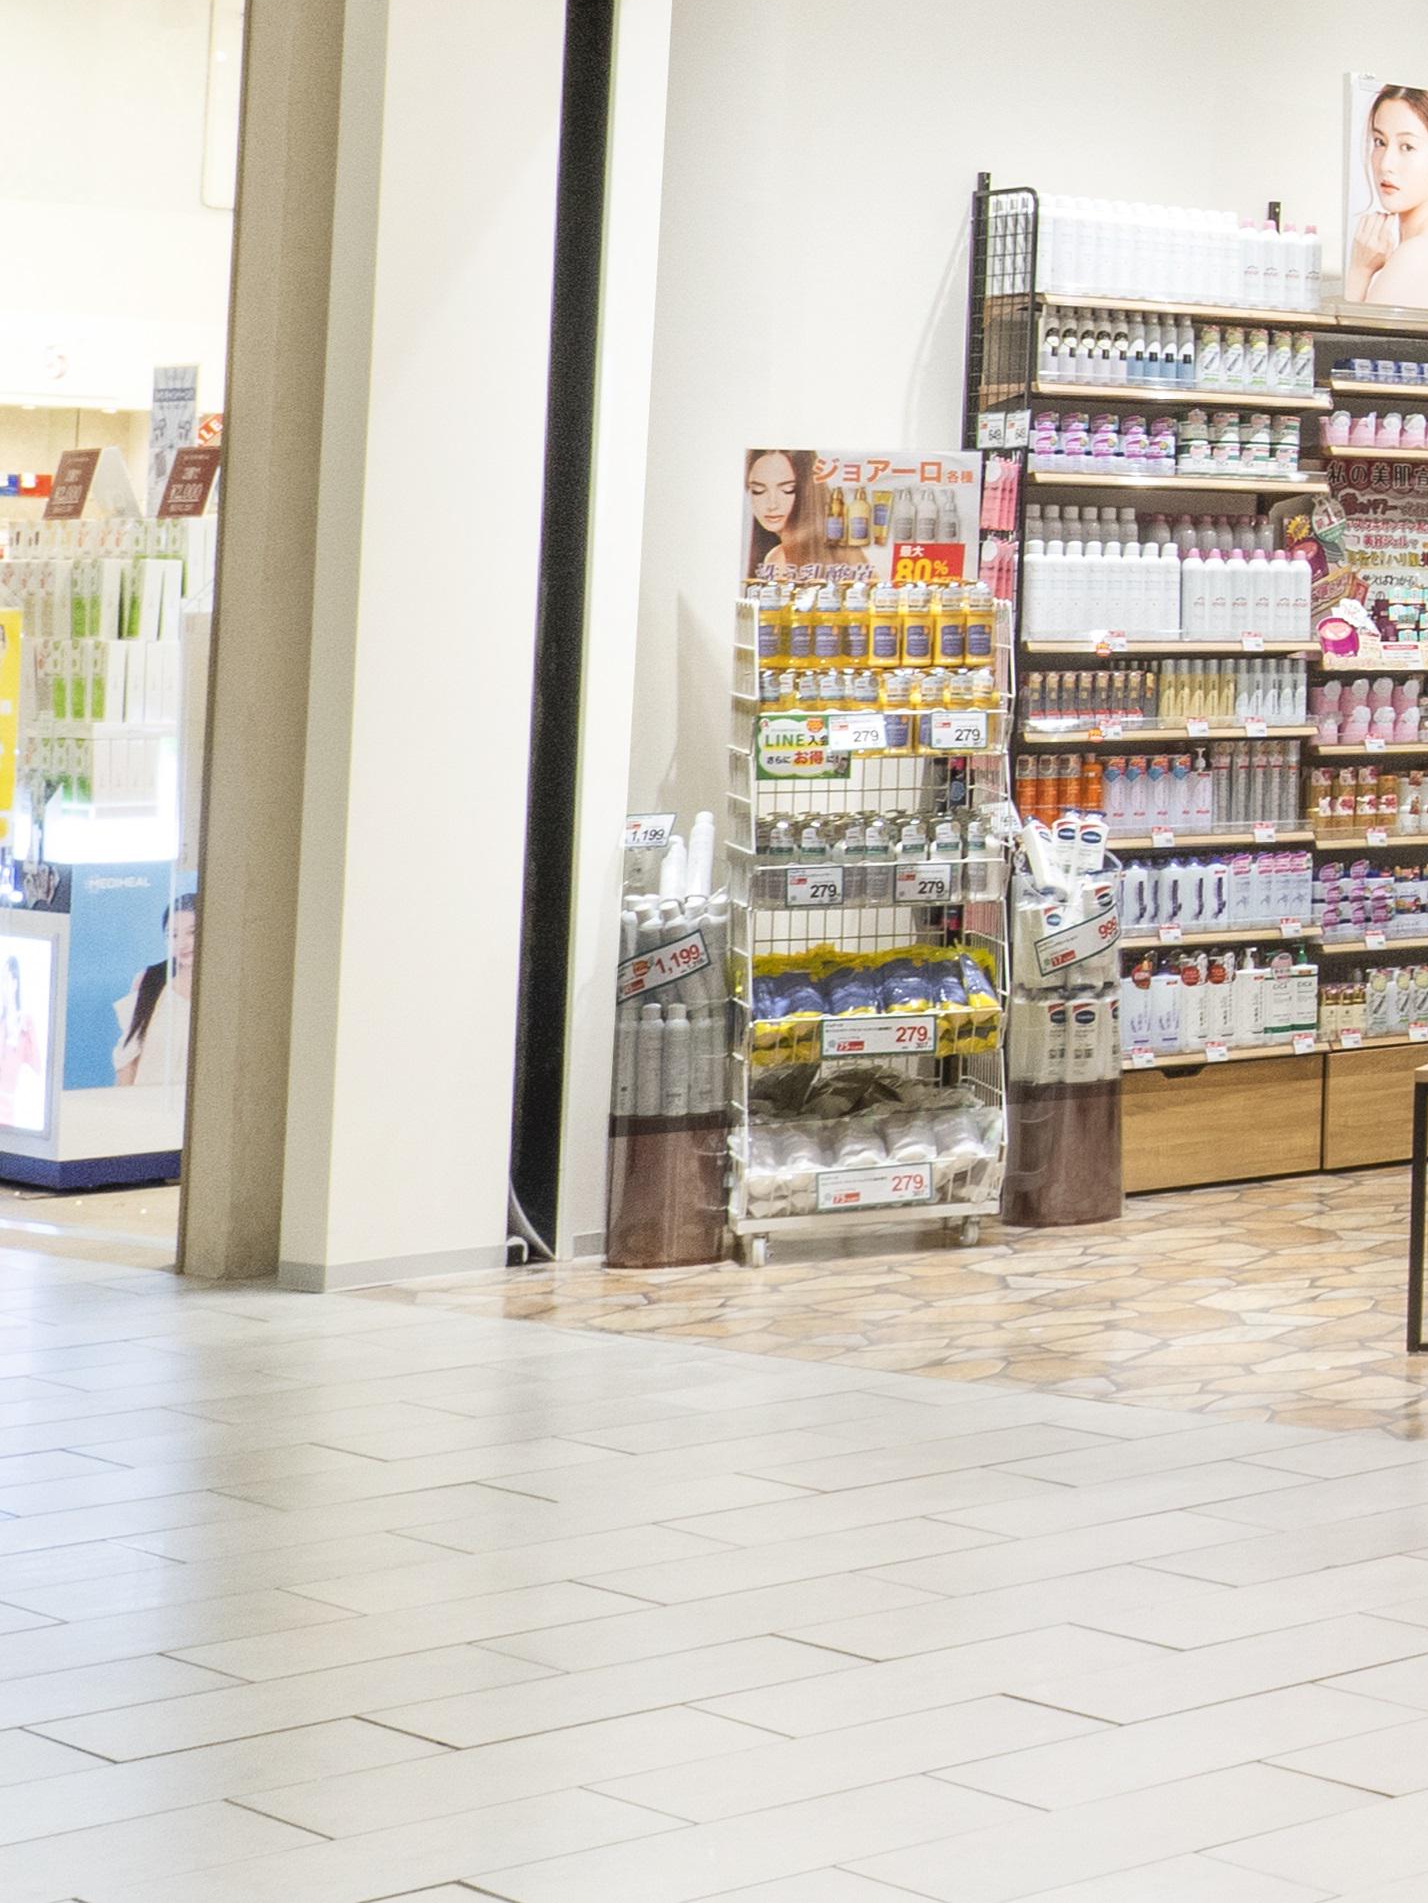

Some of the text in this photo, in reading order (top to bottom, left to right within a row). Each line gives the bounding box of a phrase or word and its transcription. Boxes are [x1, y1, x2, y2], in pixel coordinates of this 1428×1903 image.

[853, 730, 880, 743] 279
[954, 728, 982, 742] 279
[631, 829, 665, 841] 1,199
[809, 884, 838, 899] 279
[917, 881, 945, 895] 279
[654, 944, 701, 975] 1,199
[895, 1026, 929, 1043] 279
[891, 1175, 924, 1192] 279
